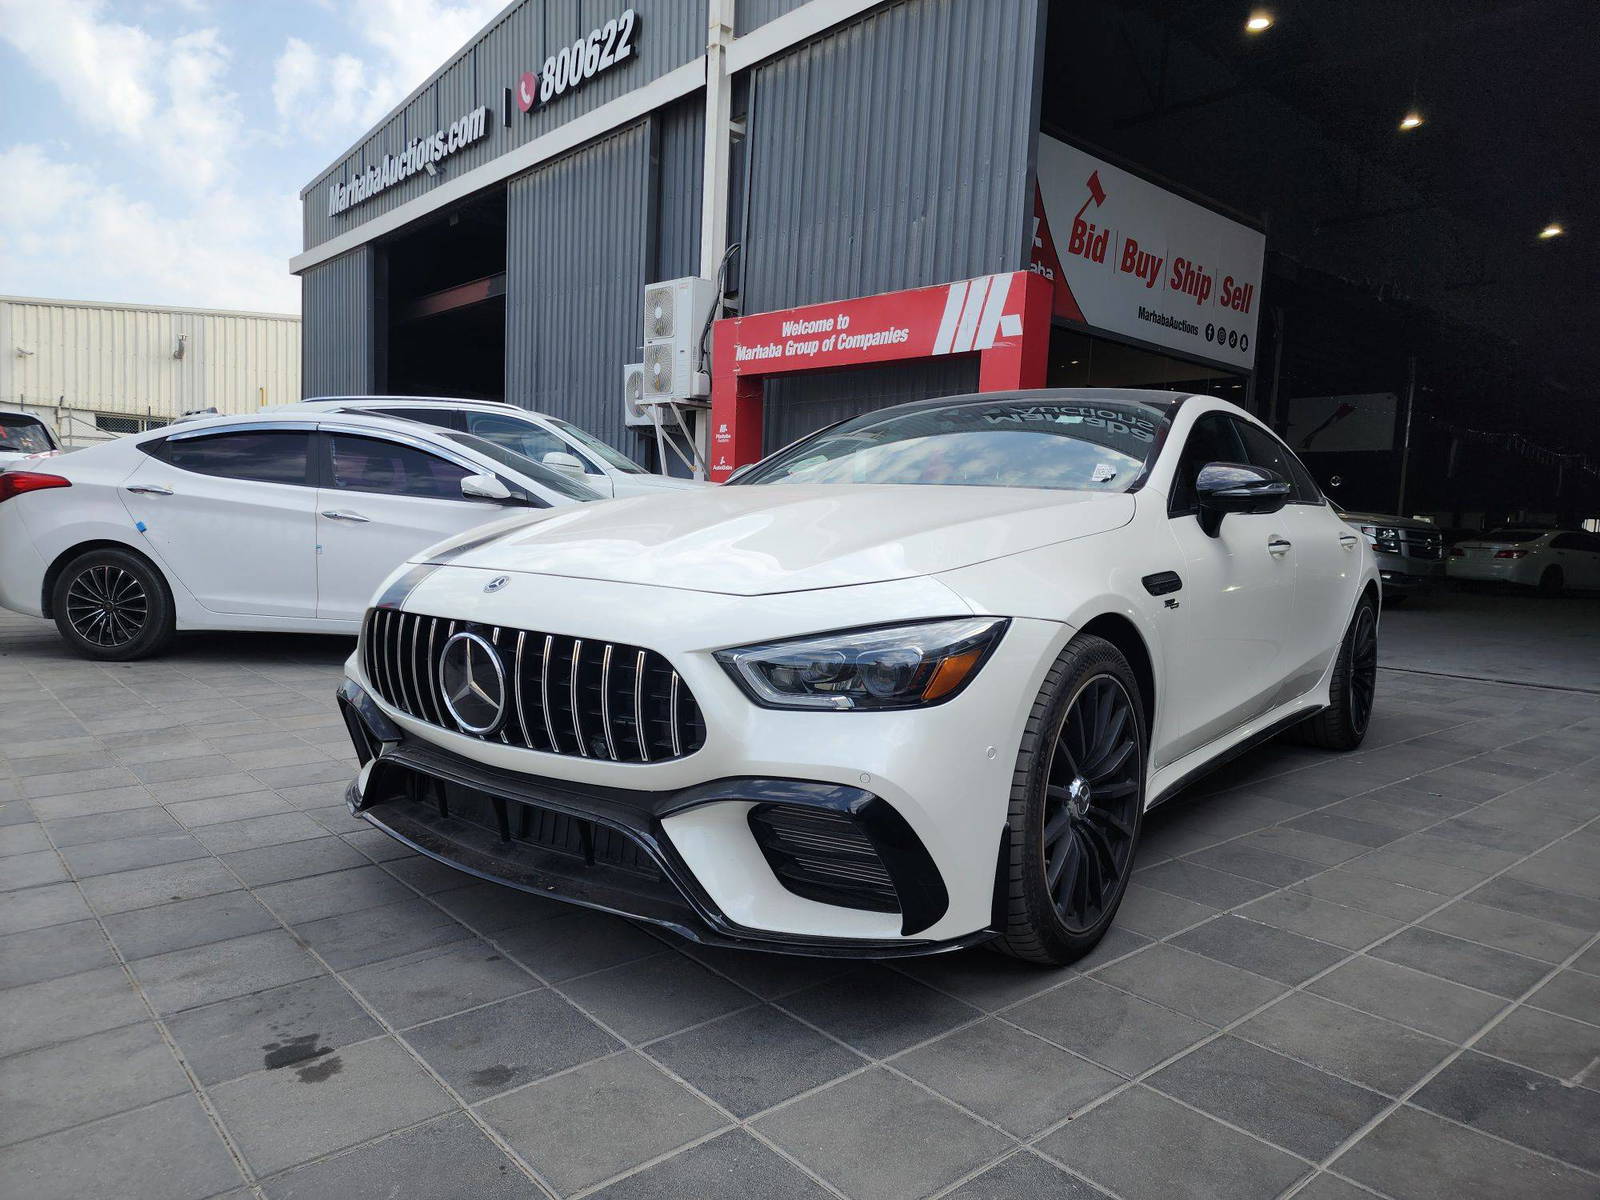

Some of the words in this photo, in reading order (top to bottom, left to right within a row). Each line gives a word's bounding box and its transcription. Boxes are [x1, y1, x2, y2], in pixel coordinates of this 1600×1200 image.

[540, 9, 637, 103] 800622
[328, 105, 487, 217] MarhabaAuctions.com
[1068, 219, 1110, 264] Bid
[1120, 238, 1163, 289] Buy
[1170, 257, 1212, 306] Ship
[1220, 276, 1254, 314] Sell
[735, 344, 783, 362] Marhaba
[785, 338, 819, 359] Group
[821, 333, 836, 351] of
[837, 326, 910, 351] Companies
[781, 317, 834, 338] Welcome
[836, 313, 850, 330] to
[1137, 305, 1199, 336] MarhabaAuctions
